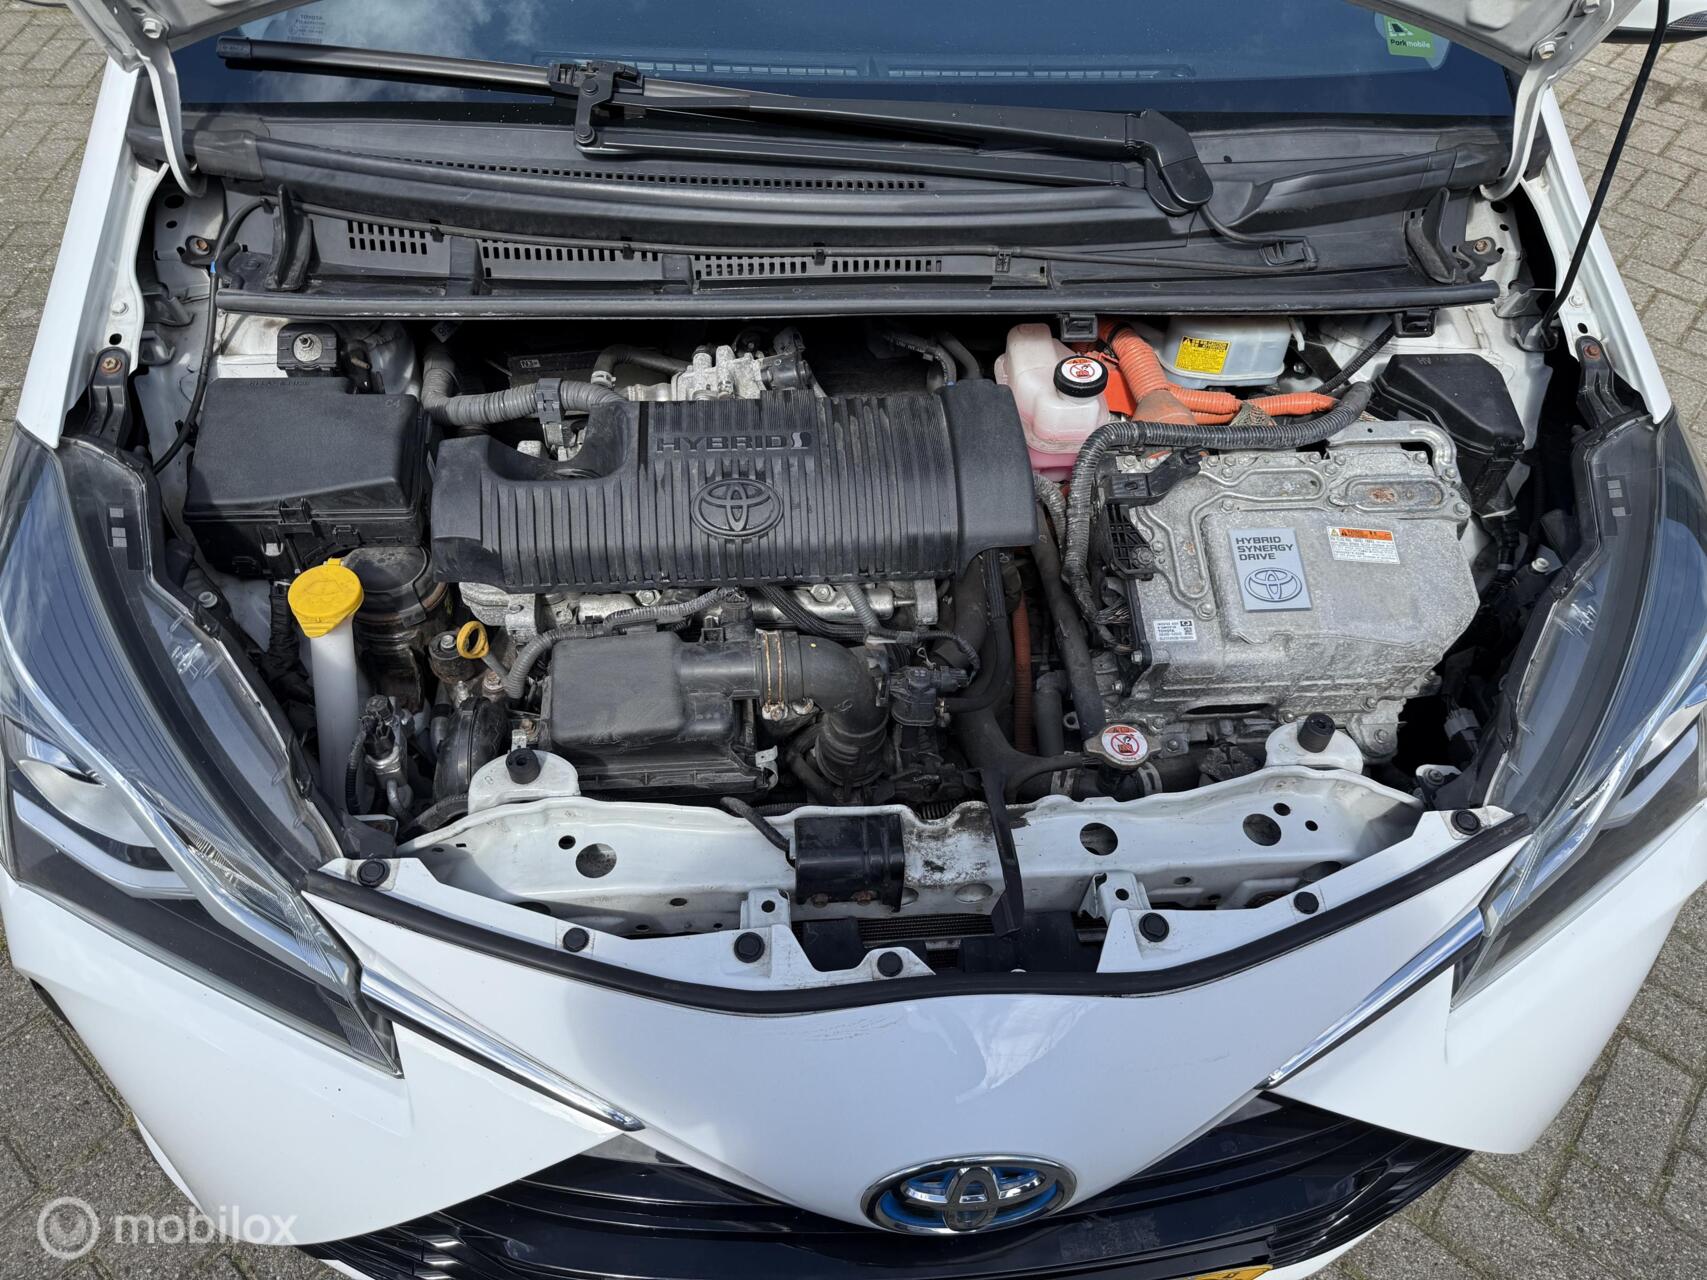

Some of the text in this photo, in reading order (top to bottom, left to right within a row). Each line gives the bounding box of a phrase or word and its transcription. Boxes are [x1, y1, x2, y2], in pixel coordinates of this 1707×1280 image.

[1390, 38, 1431, 49] Parkmobile
[655, 435, 788, 452] HYBRID
[1235, 536, 1281, 545] HYBRID
[1237, 544, 1293, 553] SYNERGY
[1239, 552, 1276, 561] DRIVE
